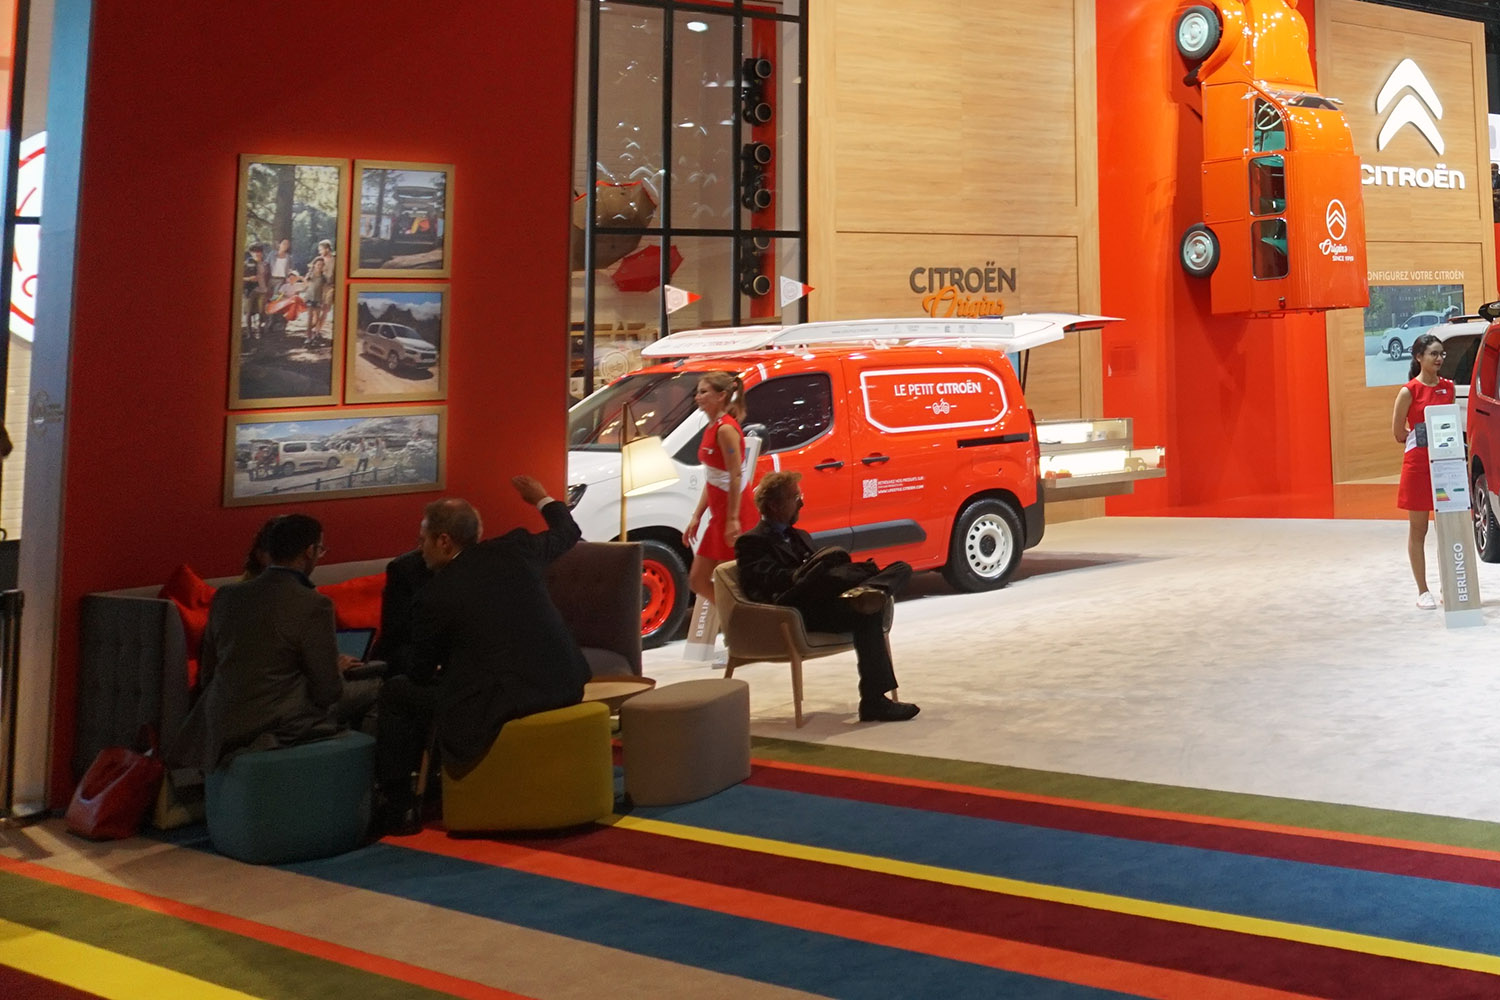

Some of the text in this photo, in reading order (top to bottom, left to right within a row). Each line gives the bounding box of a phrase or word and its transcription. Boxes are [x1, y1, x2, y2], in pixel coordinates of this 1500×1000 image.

[1360, 163, 1466, 190] CITROËN
[909, 261, 1016, 293] CITROËN
[1410, 271, 1433, 281] VOTRE
[1434, 269, 1464, 280] CITROËN
[922, 285, 1005, 318] Origins
[894, 379, 982, 396] LE PETIT CITROËN
[1453, 543, 1468, 602] BERLINGO
